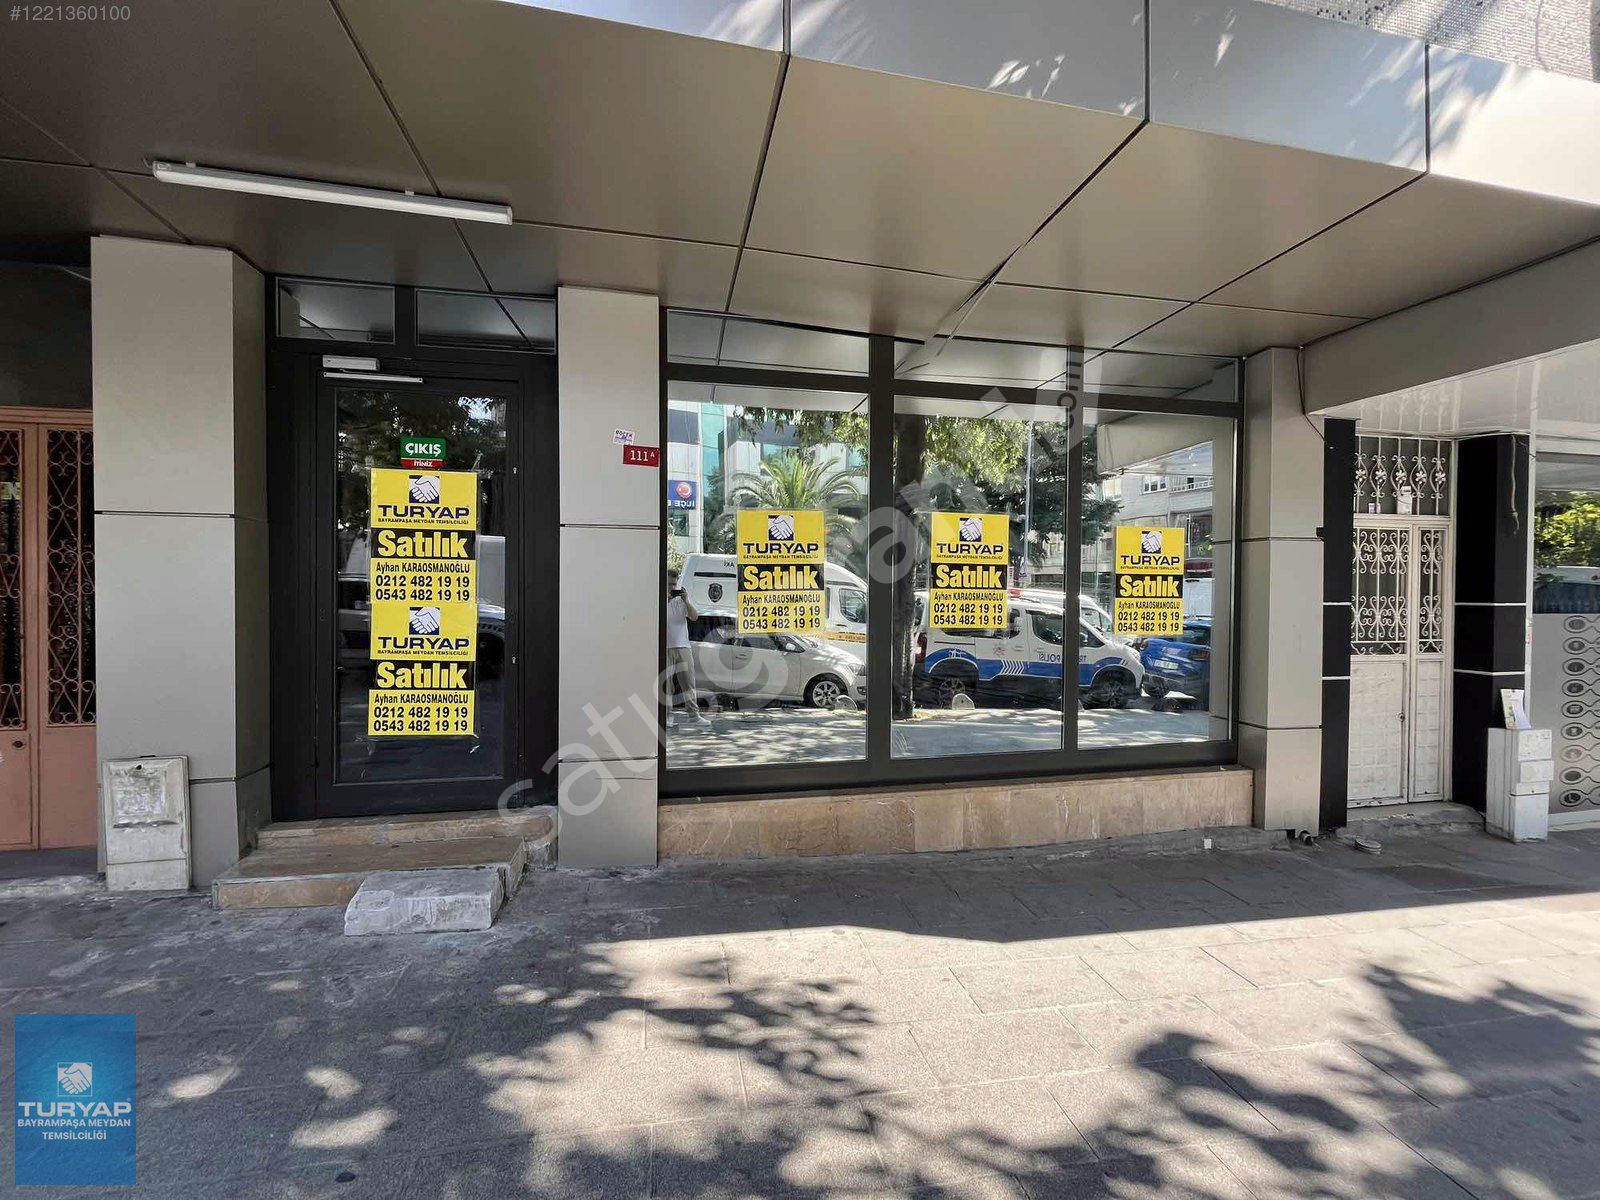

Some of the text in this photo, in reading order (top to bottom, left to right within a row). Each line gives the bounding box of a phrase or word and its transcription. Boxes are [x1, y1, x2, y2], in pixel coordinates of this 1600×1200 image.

[405, 443, 441, 457] ÇIKIŞ
[378, 505, 470, 519] TURYAP
[378, 530, 468, 558] Satılık
[743, 543, 819, 554] TURYAP
[937, 543, 1004, 555] TURYAP
[1120, 555, 1180, 566] TURYAP
[376, 561, 470, 574] Ayhan KARAOSMANOĞLU
[376, 575, 470, 588] 0212 482 19 19
[743, 565, 819, 590] Satılık
[936, 564, 1002, 588] Satılık
[1120, 575, 1179, 597] Satılık
[376, 589, 470, 602] 0543 482 19 19
[743, 595, 762, 606] Ayhan
[743, 606, 821, 617] 0212 482 19 19
[934, 603, 1003, 613] 0212 482 19 19
[934, 615, 1003, 625] 0543 482 19 19
[1118, 611, 1179, 621] 0212 482 19 19
[743, 618, 821, 629] 0543 482 19 19
[1118, 622, 1179, 631] 0543 482 19 19
[378, 637, 469, 650] TURYAP
[377, 661, 468, 689] Satılık
[374, 692, 468, 706] Ayhan KARAOSMANOĞLU
[374, 706, 468, 718] 0212 482 19 19
[374, 720, 468, 732] 0543 482 19 19
